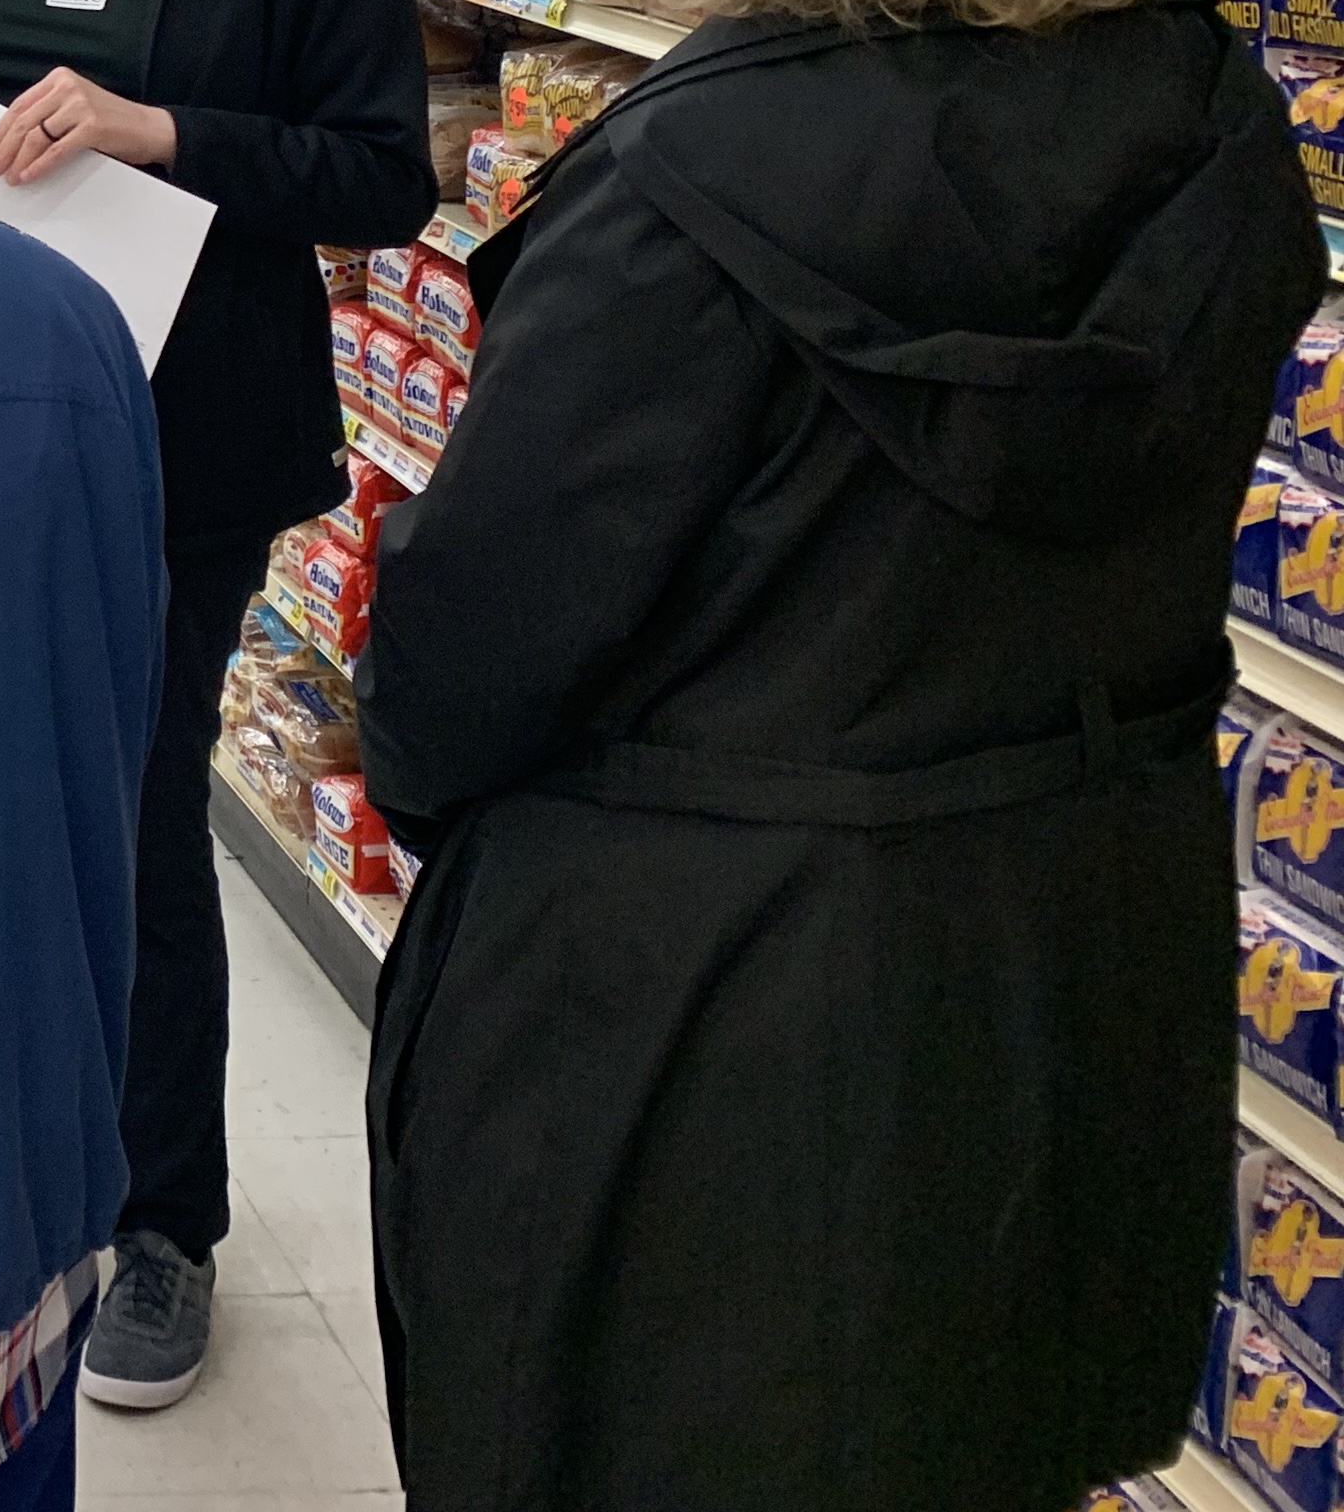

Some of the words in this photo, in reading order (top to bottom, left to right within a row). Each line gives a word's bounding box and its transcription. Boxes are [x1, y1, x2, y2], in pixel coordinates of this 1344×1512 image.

[1269, 9, 1291, 39] OLD
[373, 255, 405, 287] Holsum
[421, 285, 462, 330] Holsum
[310, 562, 341, 598] Holsum
[313, 786, 347, 829] Holsum
